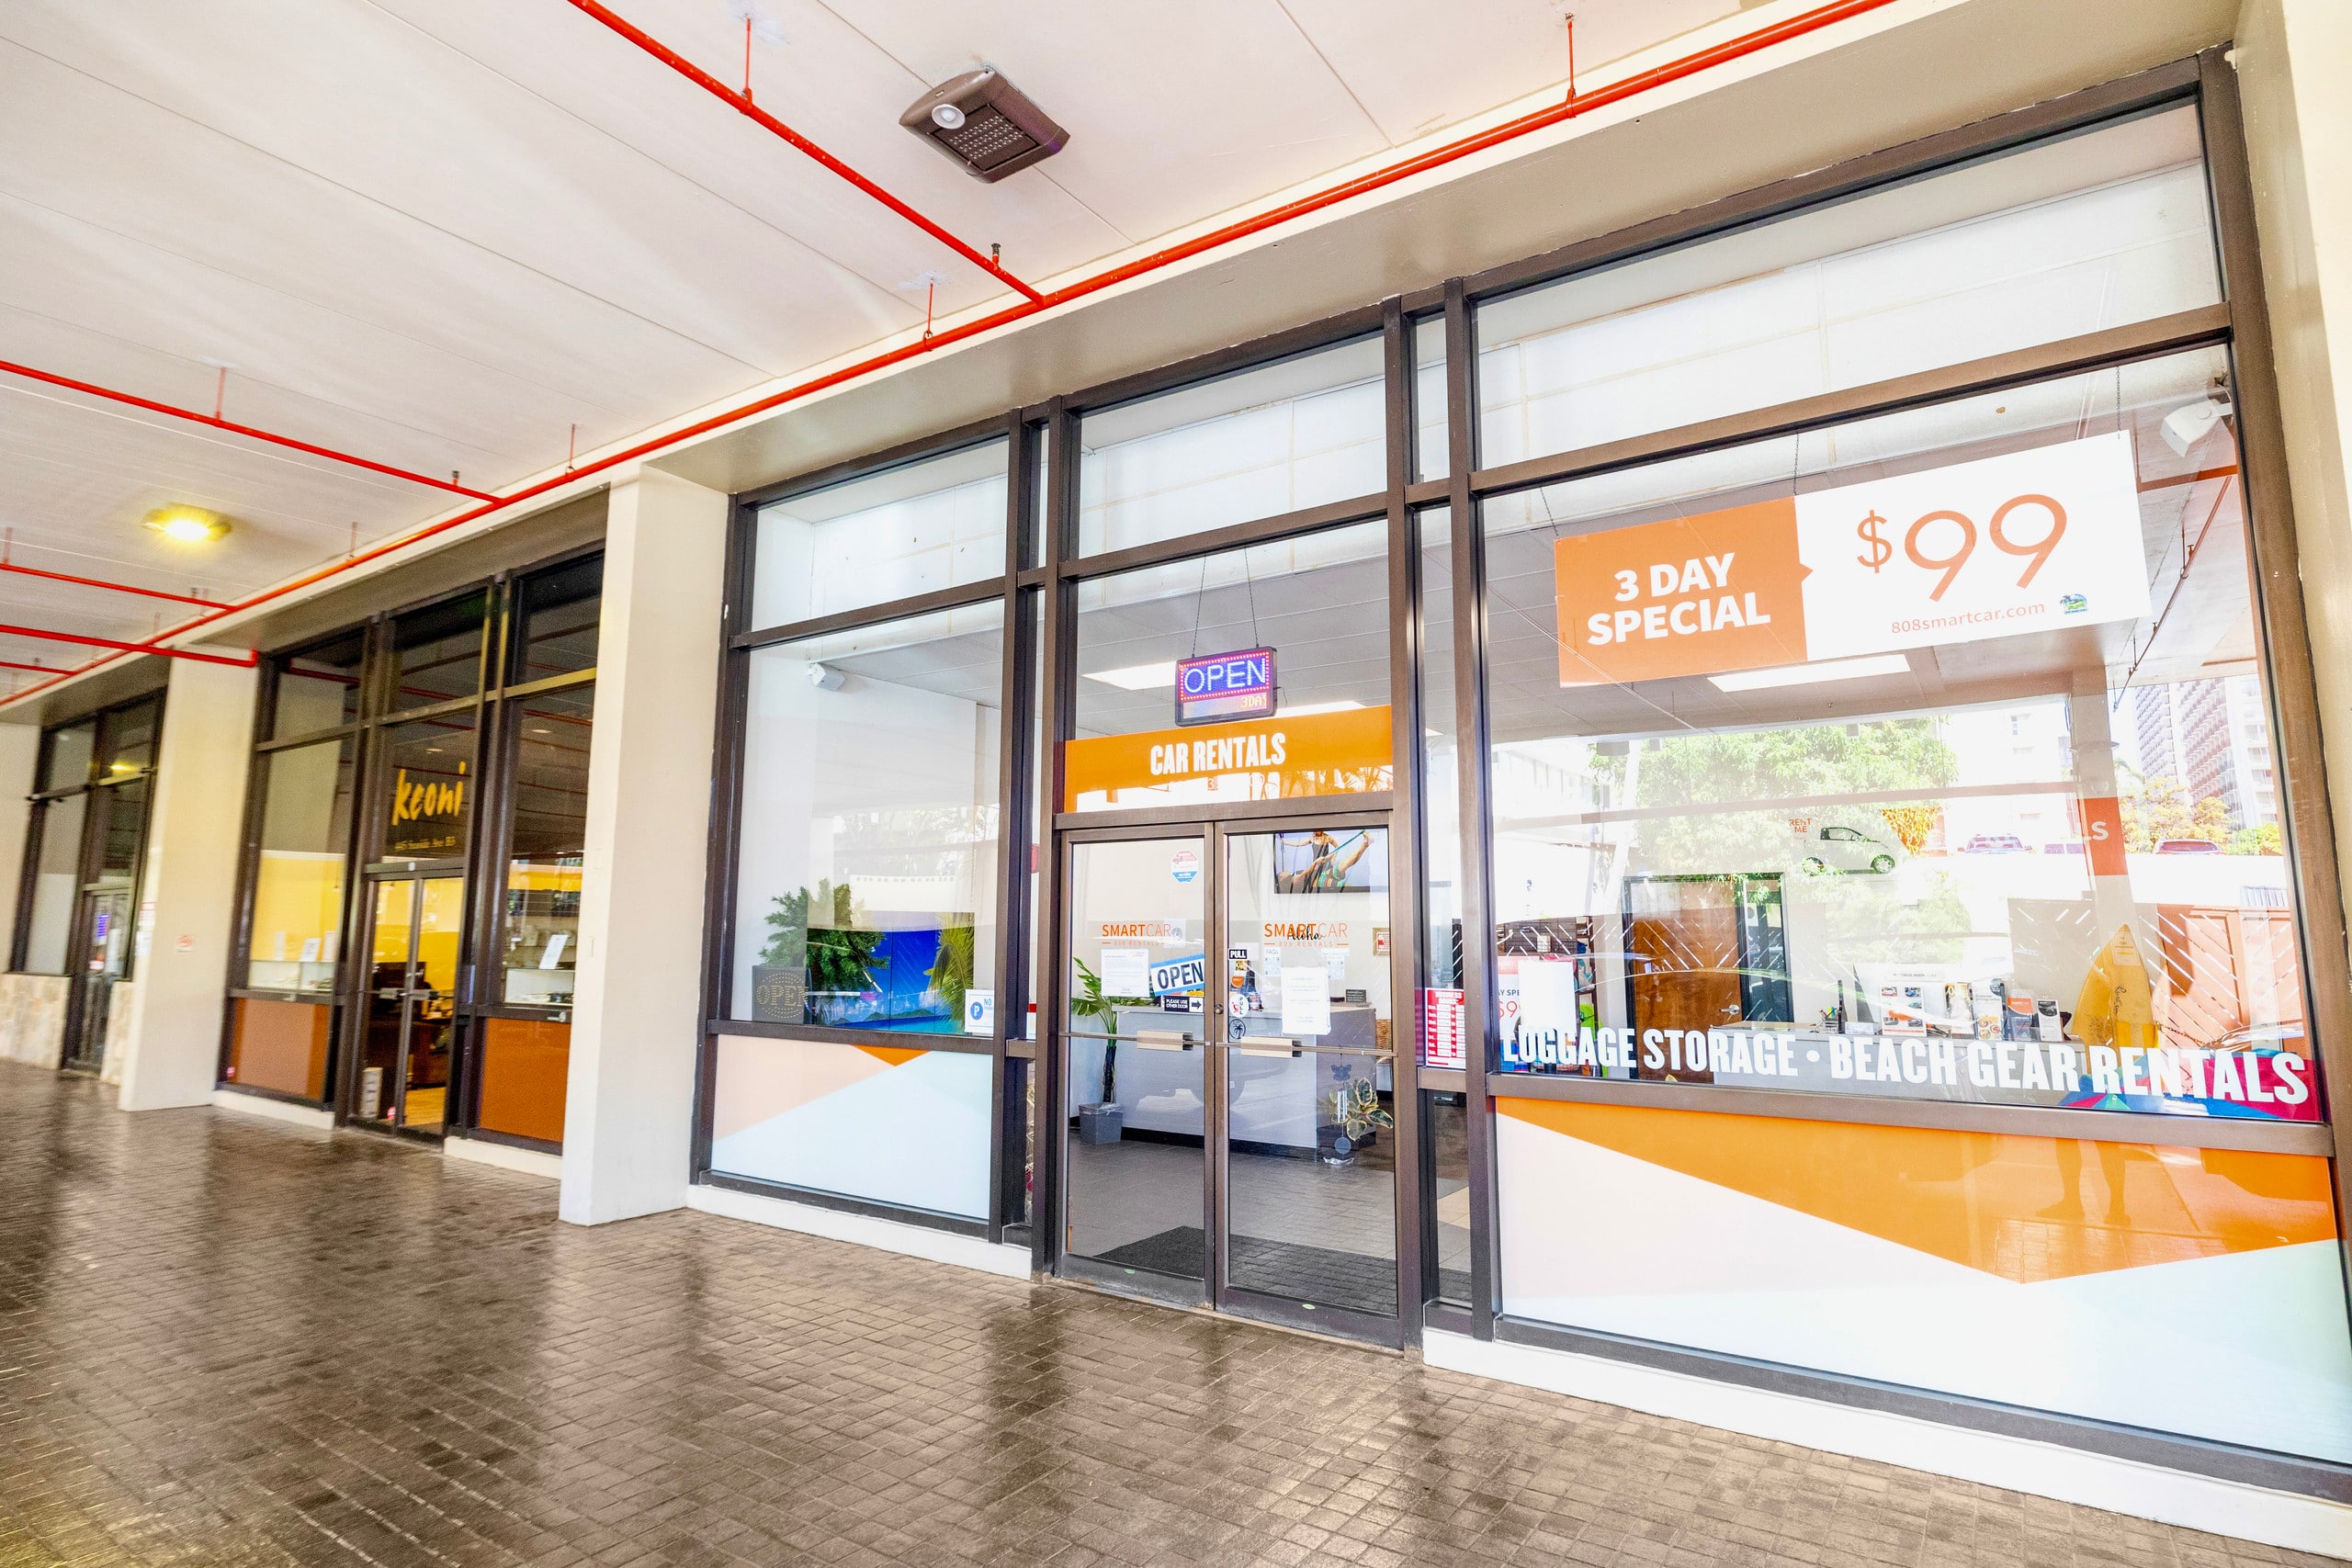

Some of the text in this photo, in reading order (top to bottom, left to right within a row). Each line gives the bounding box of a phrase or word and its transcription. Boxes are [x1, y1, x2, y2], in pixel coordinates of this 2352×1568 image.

[1857, 493, 2067, 602] $99
[1614, 552, 1735, 602] 3 DAY
[1588, 592, 1771, 645] SPECIAL
[1891, 602, 2045, 633] 808smartcar.com
[1184, 658, 1266, 694] OPEN
[1150, 732, 1286, 775] CAR RENTALS
[1790, 818, 1812, 827] RENT
[1230, 950, 1247, 958] PULL
[1158, 961, 1204, 989] OPEN
[1503, 1025, 1636, 1068] LUGGAGE
[1643, 1028, 1799, 1077] STORAGE
[1829, 1032, 1958, 1085] BEACH
[1967, 1041, 2081, 1093] GEAR
[2090, 1045, 2309, 1105] RENTALS
